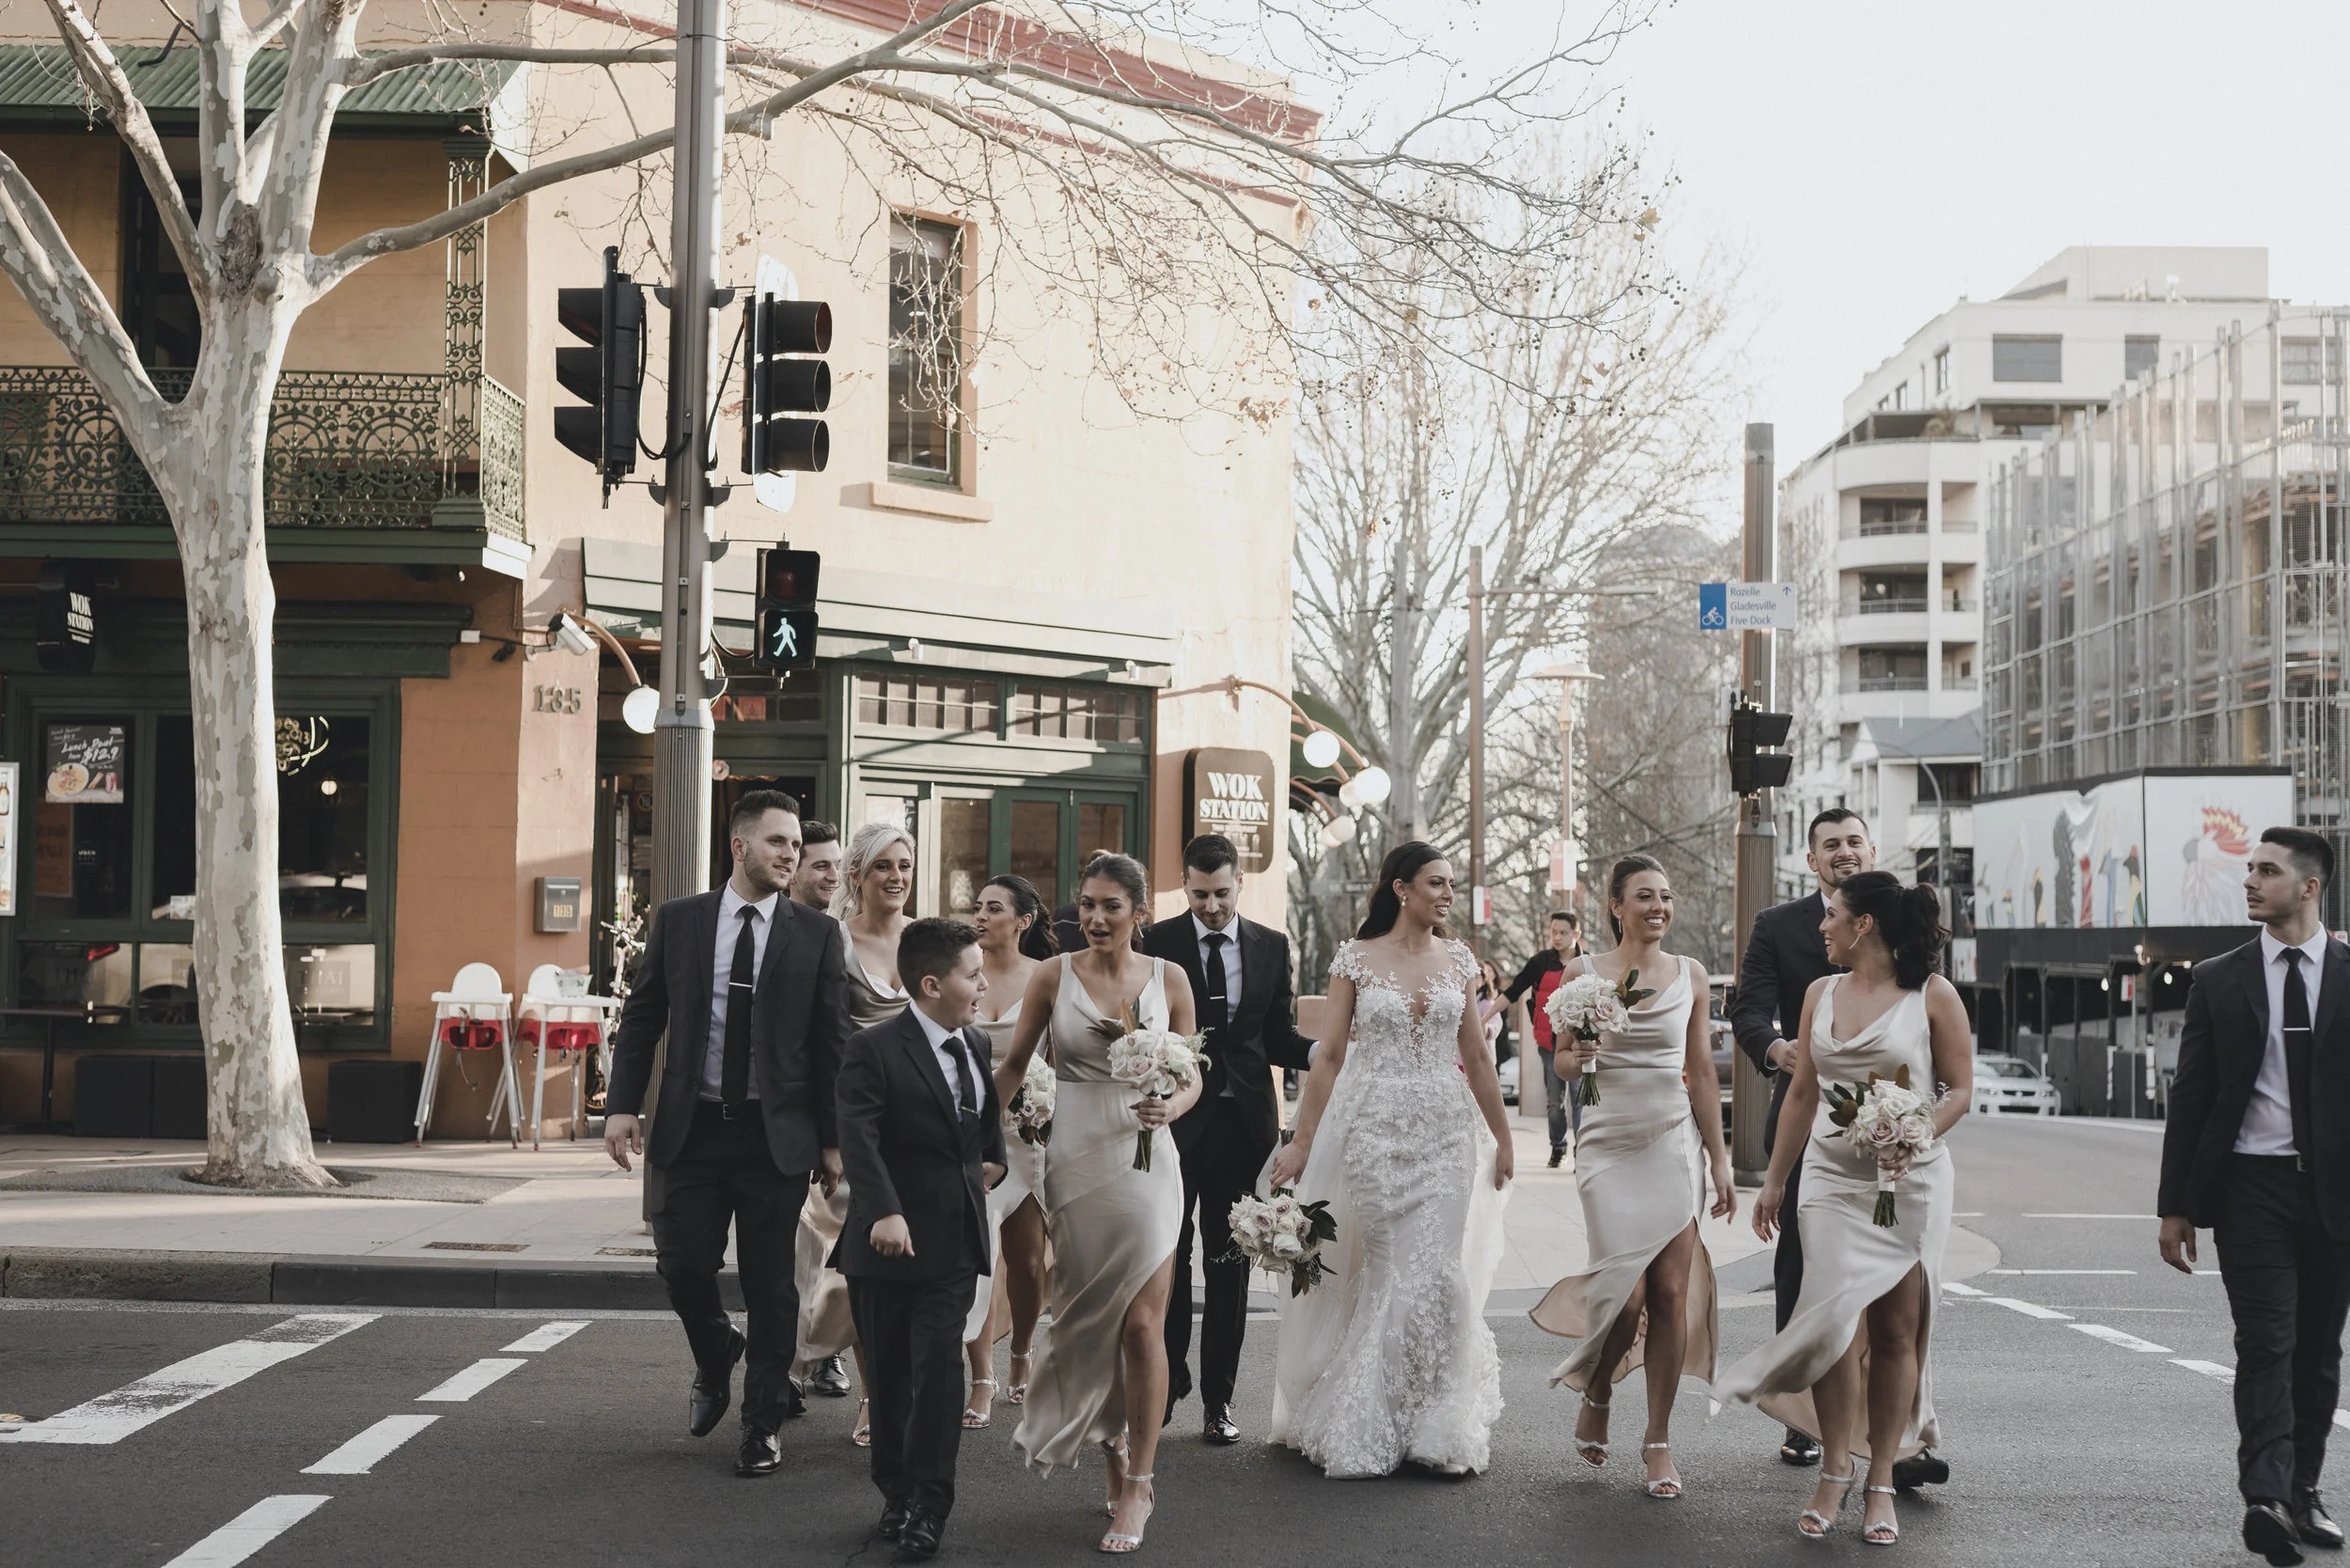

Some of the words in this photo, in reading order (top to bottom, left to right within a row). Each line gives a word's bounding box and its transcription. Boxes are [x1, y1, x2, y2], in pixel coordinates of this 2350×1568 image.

[1730, 587, 1761, 597] Rozelle
[69, 591, 92, 617] WOK
[1730, 601, 1777, 611] Gladesville
[67, 611, 94, 633] STATION
[1730, 615, 1747, 625] Five
[1749, 615, 1772, 625] Dock
[537, 683, 583, 714] 135
[60, 739, 87, 754] Lunch
[91, 736, 114, 747] Deal
[1207, 771, 1264, 800] WOK
[1199, 798, 1270, 821] STATION
[555, 905, 572, 917] 135
